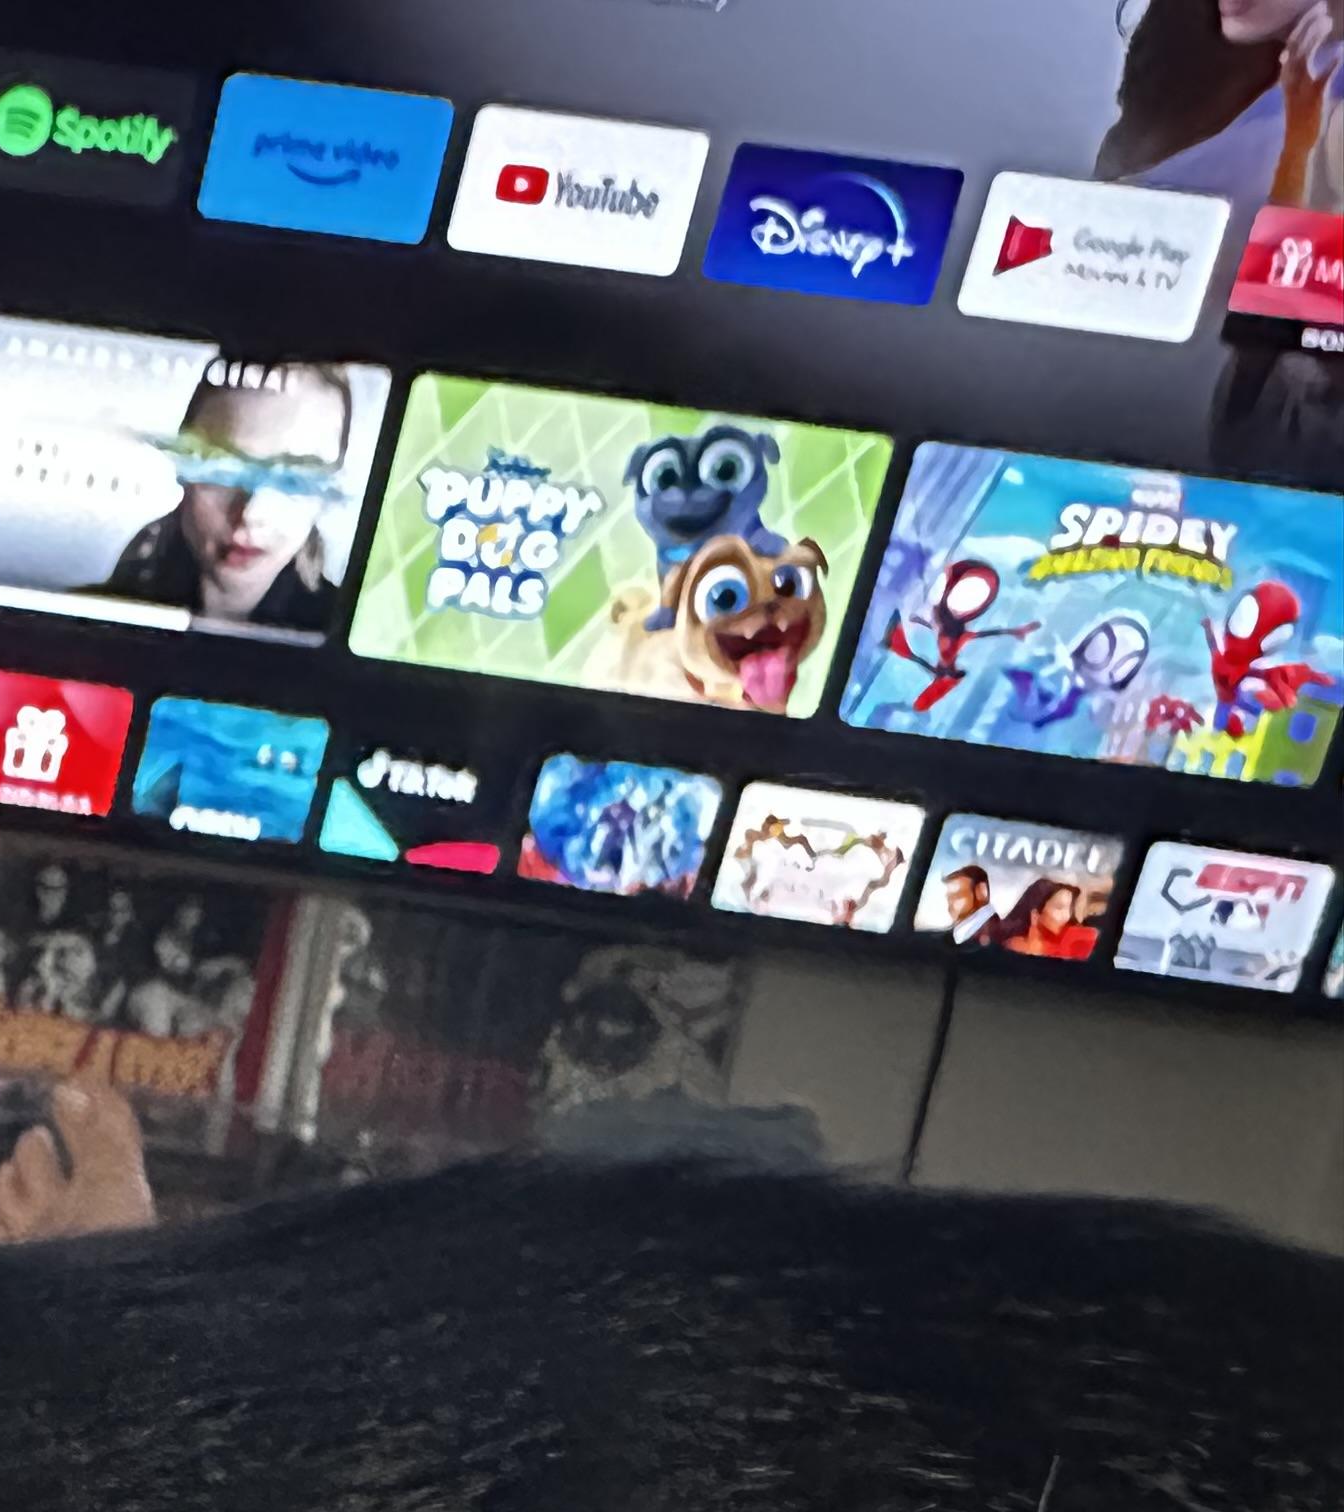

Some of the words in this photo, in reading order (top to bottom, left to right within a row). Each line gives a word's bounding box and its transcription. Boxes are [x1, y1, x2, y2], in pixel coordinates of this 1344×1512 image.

[53, 105, 178, 165] Spotify
[555, 170, 659, 219] YouTube
[419, 466, 604, 534] PUPPY
[440, 517, 560, 570] DOG
[1050, 502, 1239, 562] SPIDEY
[425, 565, 545, 616] PALS
